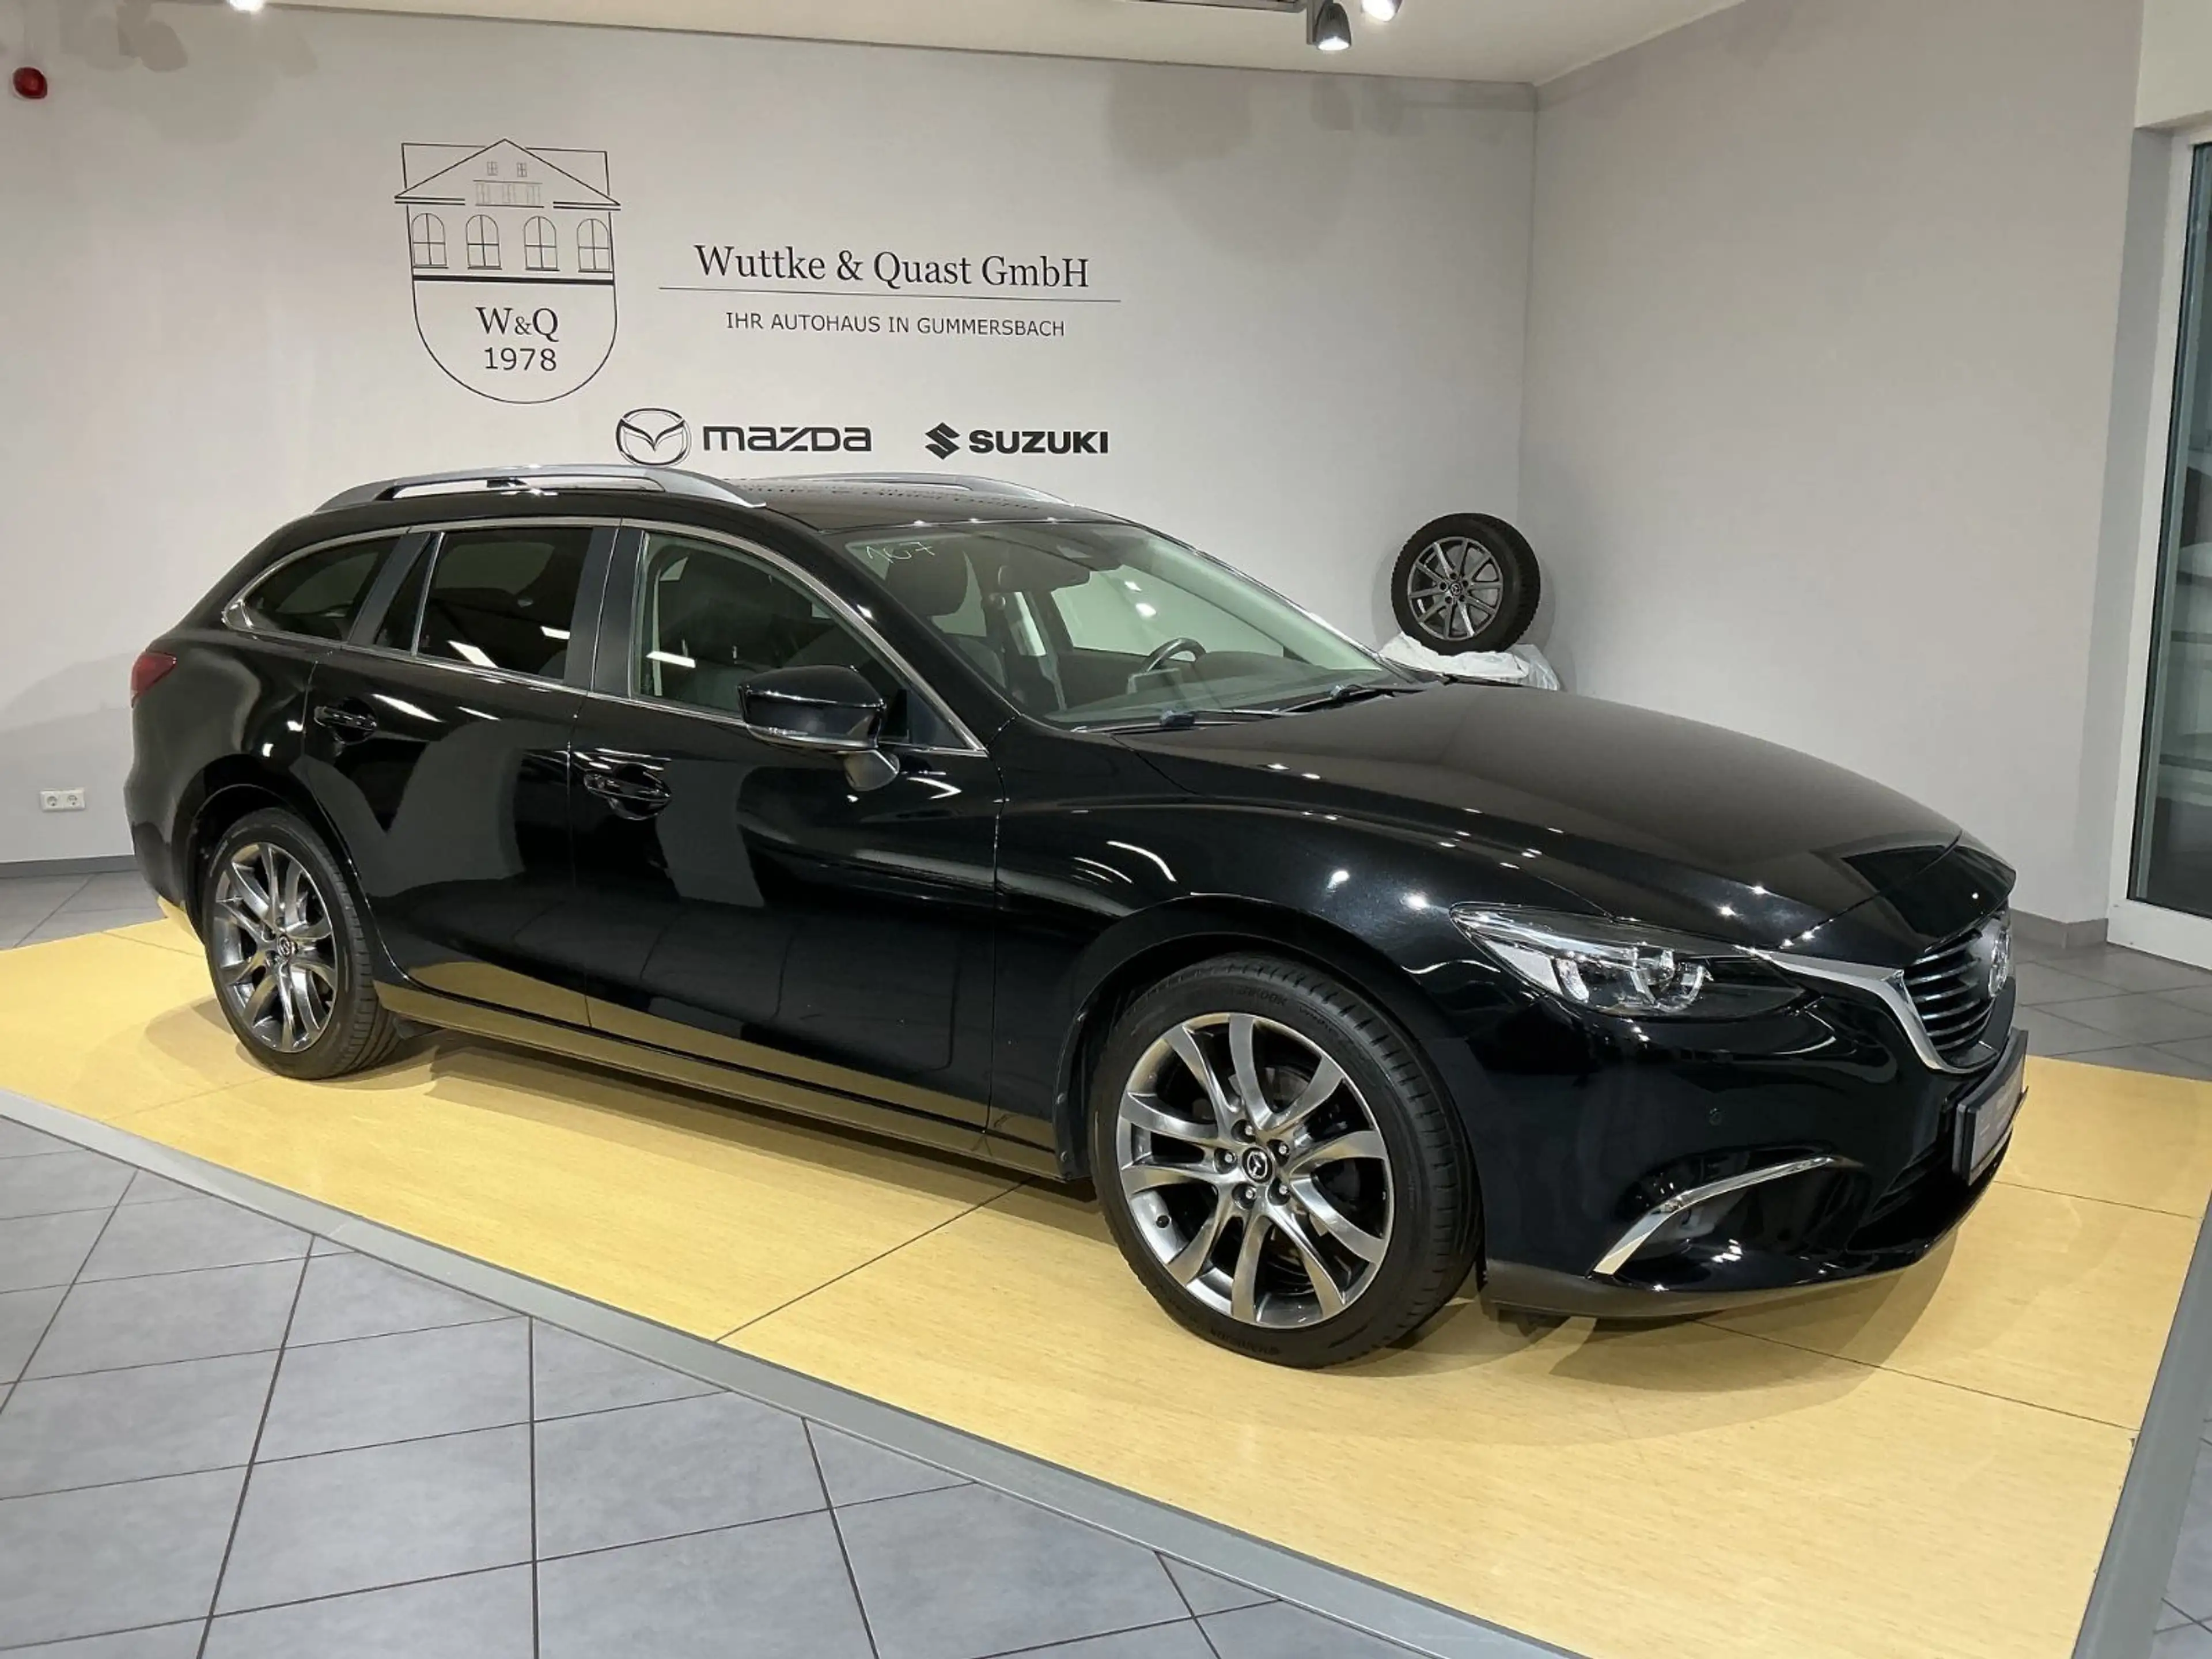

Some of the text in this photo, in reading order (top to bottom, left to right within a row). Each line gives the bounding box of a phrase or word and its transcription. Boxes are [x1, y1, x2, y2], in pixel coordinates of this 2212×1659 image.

[693, 244, 1089, 290] Wuttke & Quast GmbH
[475, 306, 559, 342] W&Q
[726, 312, 1065, 338] IHR AUTOHAUS IN GUMMERSBACH
[484, 347, 557, 372] 1978
[968, 429, 1109, 454] SUZUKI
